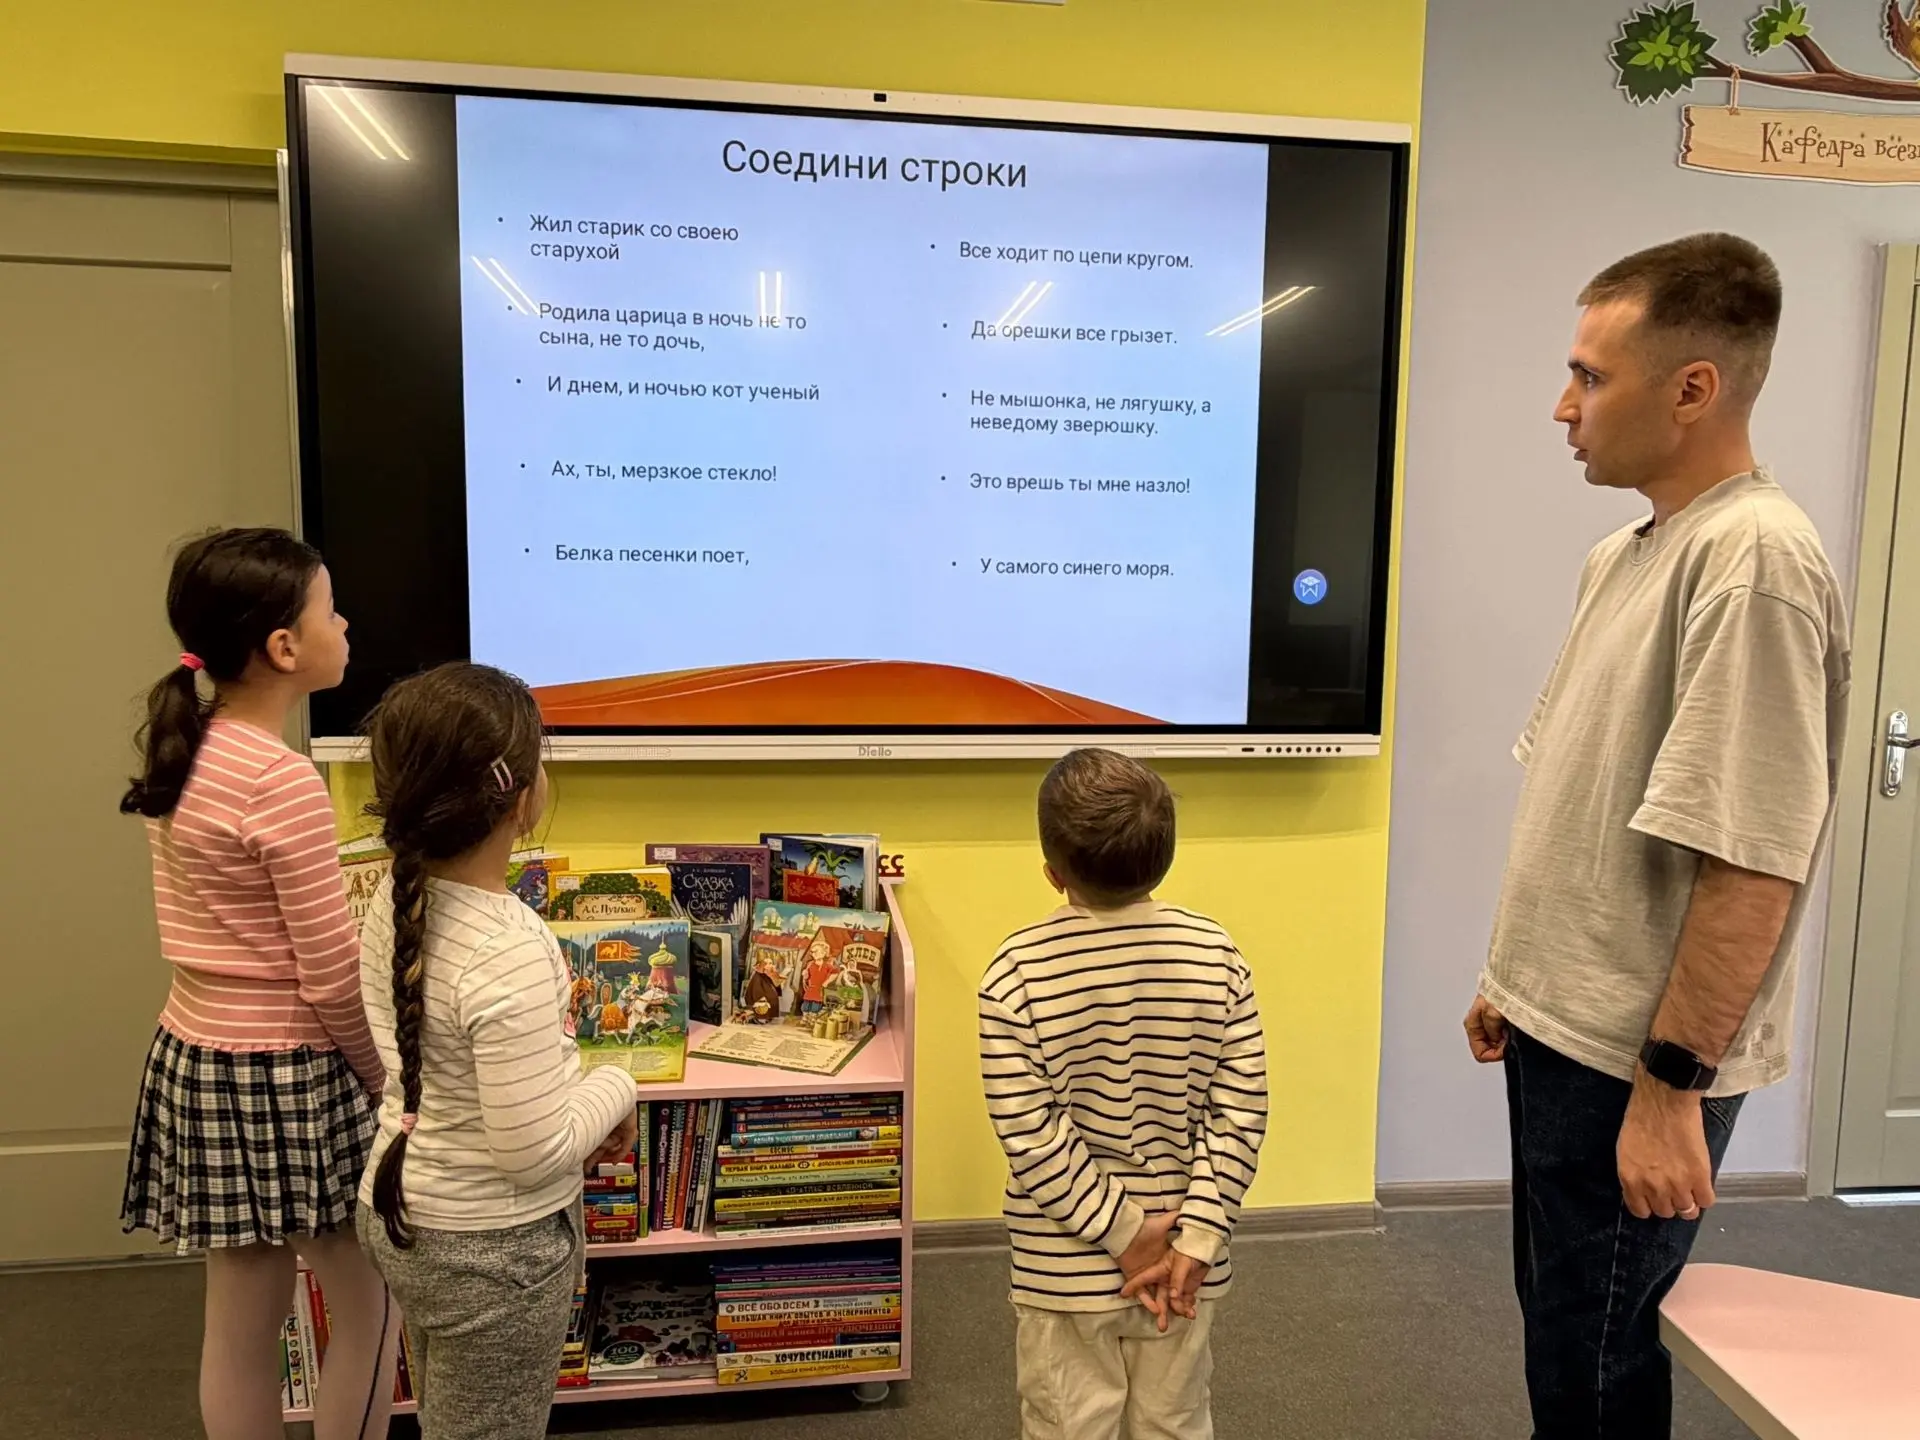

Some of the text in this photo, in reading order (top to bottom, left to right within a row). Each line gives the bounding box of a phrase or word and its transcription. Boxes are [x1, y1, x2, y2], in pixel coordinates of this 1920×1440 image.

[1760, 122, 1866, 168] Кафедра
[722, 140, 1026, 192] Соедини строки
[528, 214, 738, 242] Жил старик со своею
[530, 242, 620, 262] старухой
[960, 242, 1194, 271] Все ходит по цепи кругом.
[538, 302, 807, 330] Родила царица в ночь не то
[538, 330, 705, 352] сына, не то дочь,
[971, 320, 1178, 346] Да орешки все грызет.
[548, 376, 820, 402] И днем, и ночью кот ученый
[970, 390, 1211, 416] Не мышонка, не лягушку, а
[970, 415, 1159, 438] неведому зверюшку.
[551, 460, 778, 482] Ах, ты, мерзкое стекло!
[970, 472, 1190, 494] Это врешь ты мне назло!
[555, 544, 750, 566] Белка песенки поет,
[980, 558, 1174, 580] У самого синего моря.
